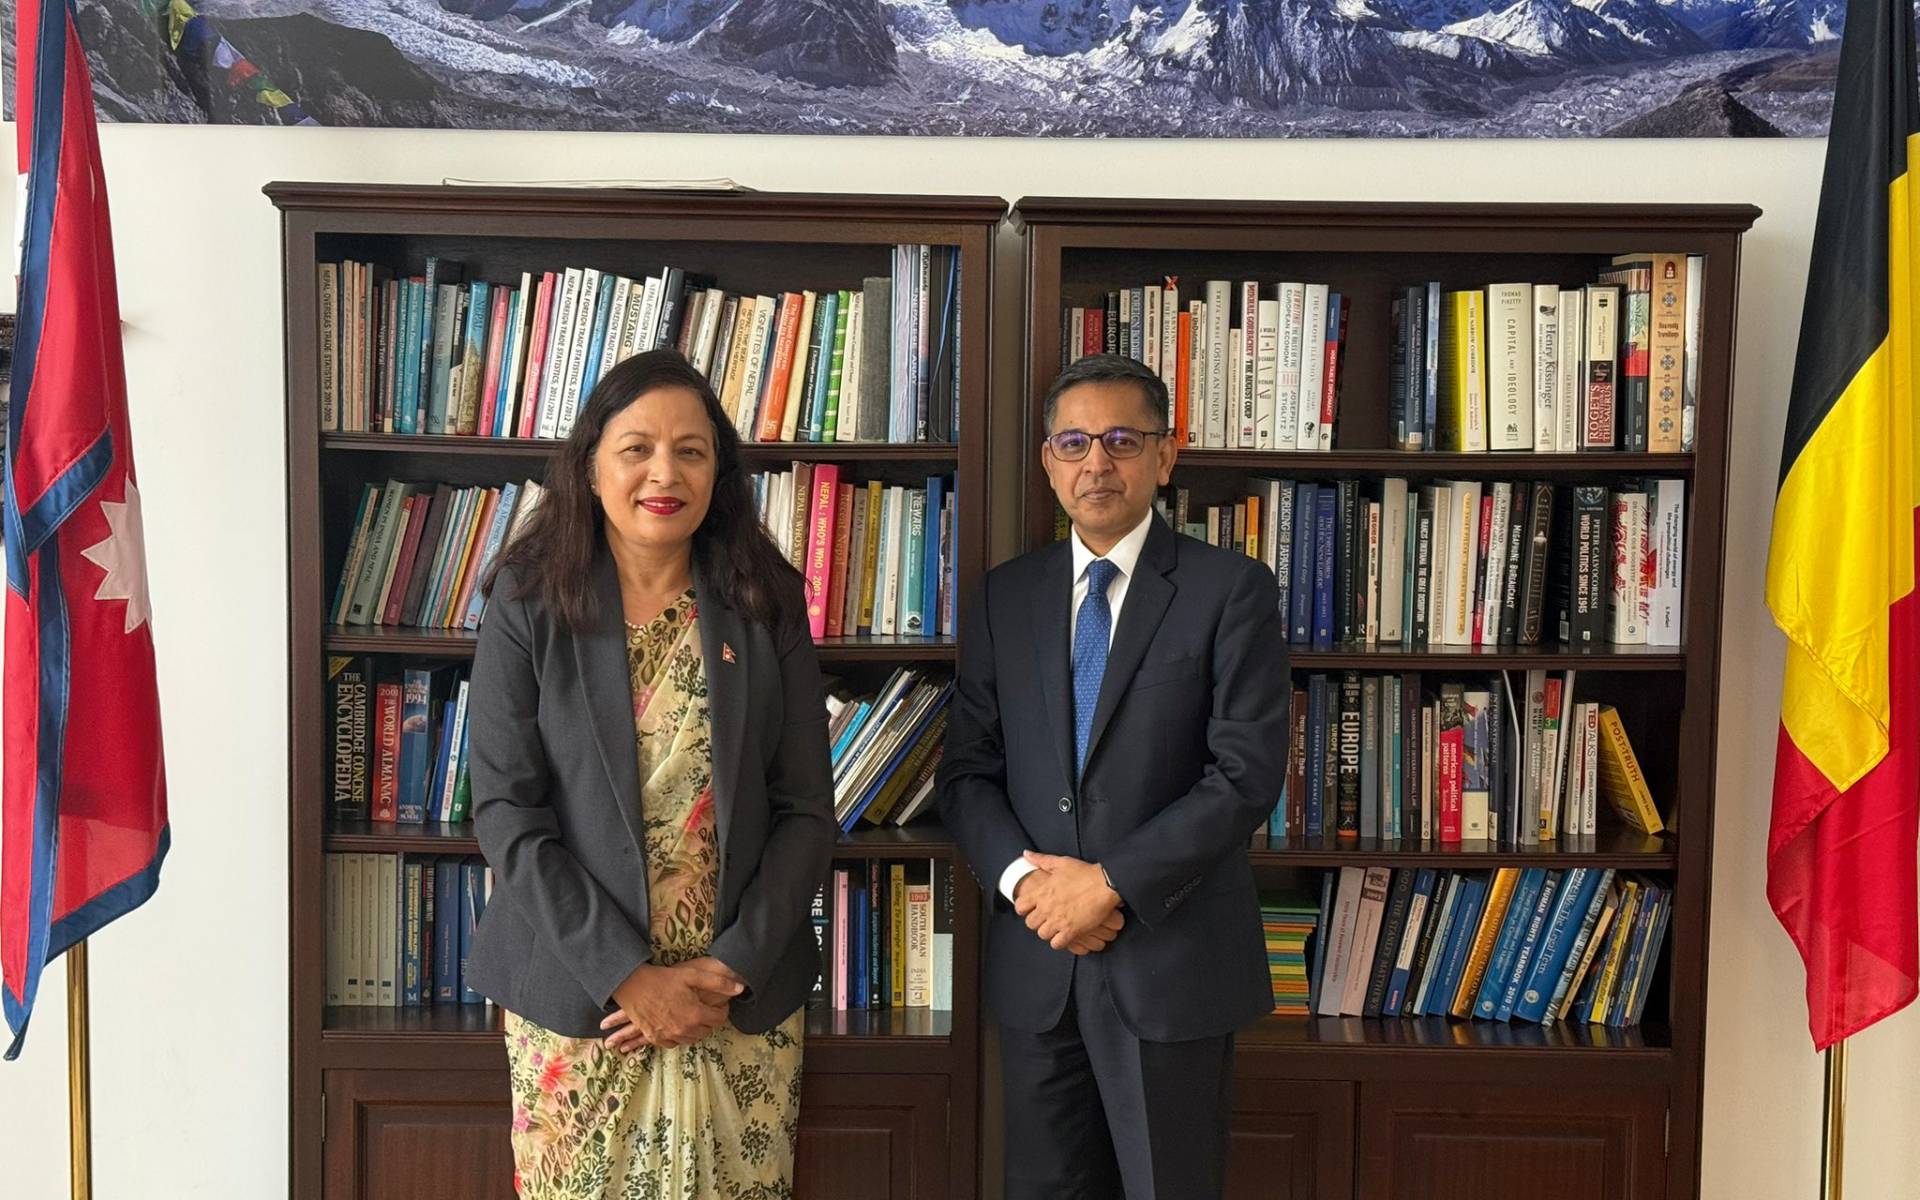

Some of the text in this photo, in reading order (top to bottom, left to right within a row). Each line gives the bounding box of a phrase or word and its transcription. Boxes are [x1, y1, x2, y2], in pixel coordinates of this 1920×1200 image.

[323, 271, 331, 290] NEPAL
[566, 276, 575, 295] NEPAL
[584, 277, 593, 296] NEPAL
[616, 283, 626, 301] NEPAL
[323, 293, 331, 328] OVERSEAS
[561, 297, 571, 325] FOREIGN
[580, 298, 590, 326] FOREIGN
[612, 303, 622, 331] FOREIGN
[624, 294, 642, 347] MUSTANG
[642, 303, 653, 330] FOREIGN
[1131, 291, 1140, 327] FOREIGN
[557, 327, 567, 346] TRADE
[576, 328, 585, 347] TRADE
[745, 309, 767, 396] VIGNETTES OF NEPAL
[1507, 319, 1516, 356] CAPITAL
[1211, 342, 1221, 424] LOSING AN ENEMY
[1541, 324, 1556, 409] Henry Kissinger
[1245, 375, 1253, 400] AUGUST
[1507, 373, 1516, 415] IDEOLOGY
[1244, 401, 1252, 419] COUP
[815, 481, 830, 569] NEPAL WHO'S WHO
[1279, 487, 1292, 587] WORKING JAPANESE
[1580, 514, 1590, 540] WORLD
[835, 535, 847, 566] Nepal
[1579, 542, 1589, 573] POLITICS
[1579, 574, 1588, 595] SINCE
[335, 684, 353, 802] ENCYCLOPEDIA
[352, 684, 366, 802] CAMBRIDGE CONCISE
[380, 706, 395, 804] WORLD ALMANAC
[1340, 711, 1360, 775] EUROPE
[1442, 743, 1450, 775] patterns
[1449, 743, 1458, 812] american political
[919, 904, 927, 957] SOUTH ASIAN
[1527, 916, 1540, 942] RIGHTS
[1538, 909, 1570, 974] The Legal Texts
[1512, 946, 1530, 984] YEARBOOK
